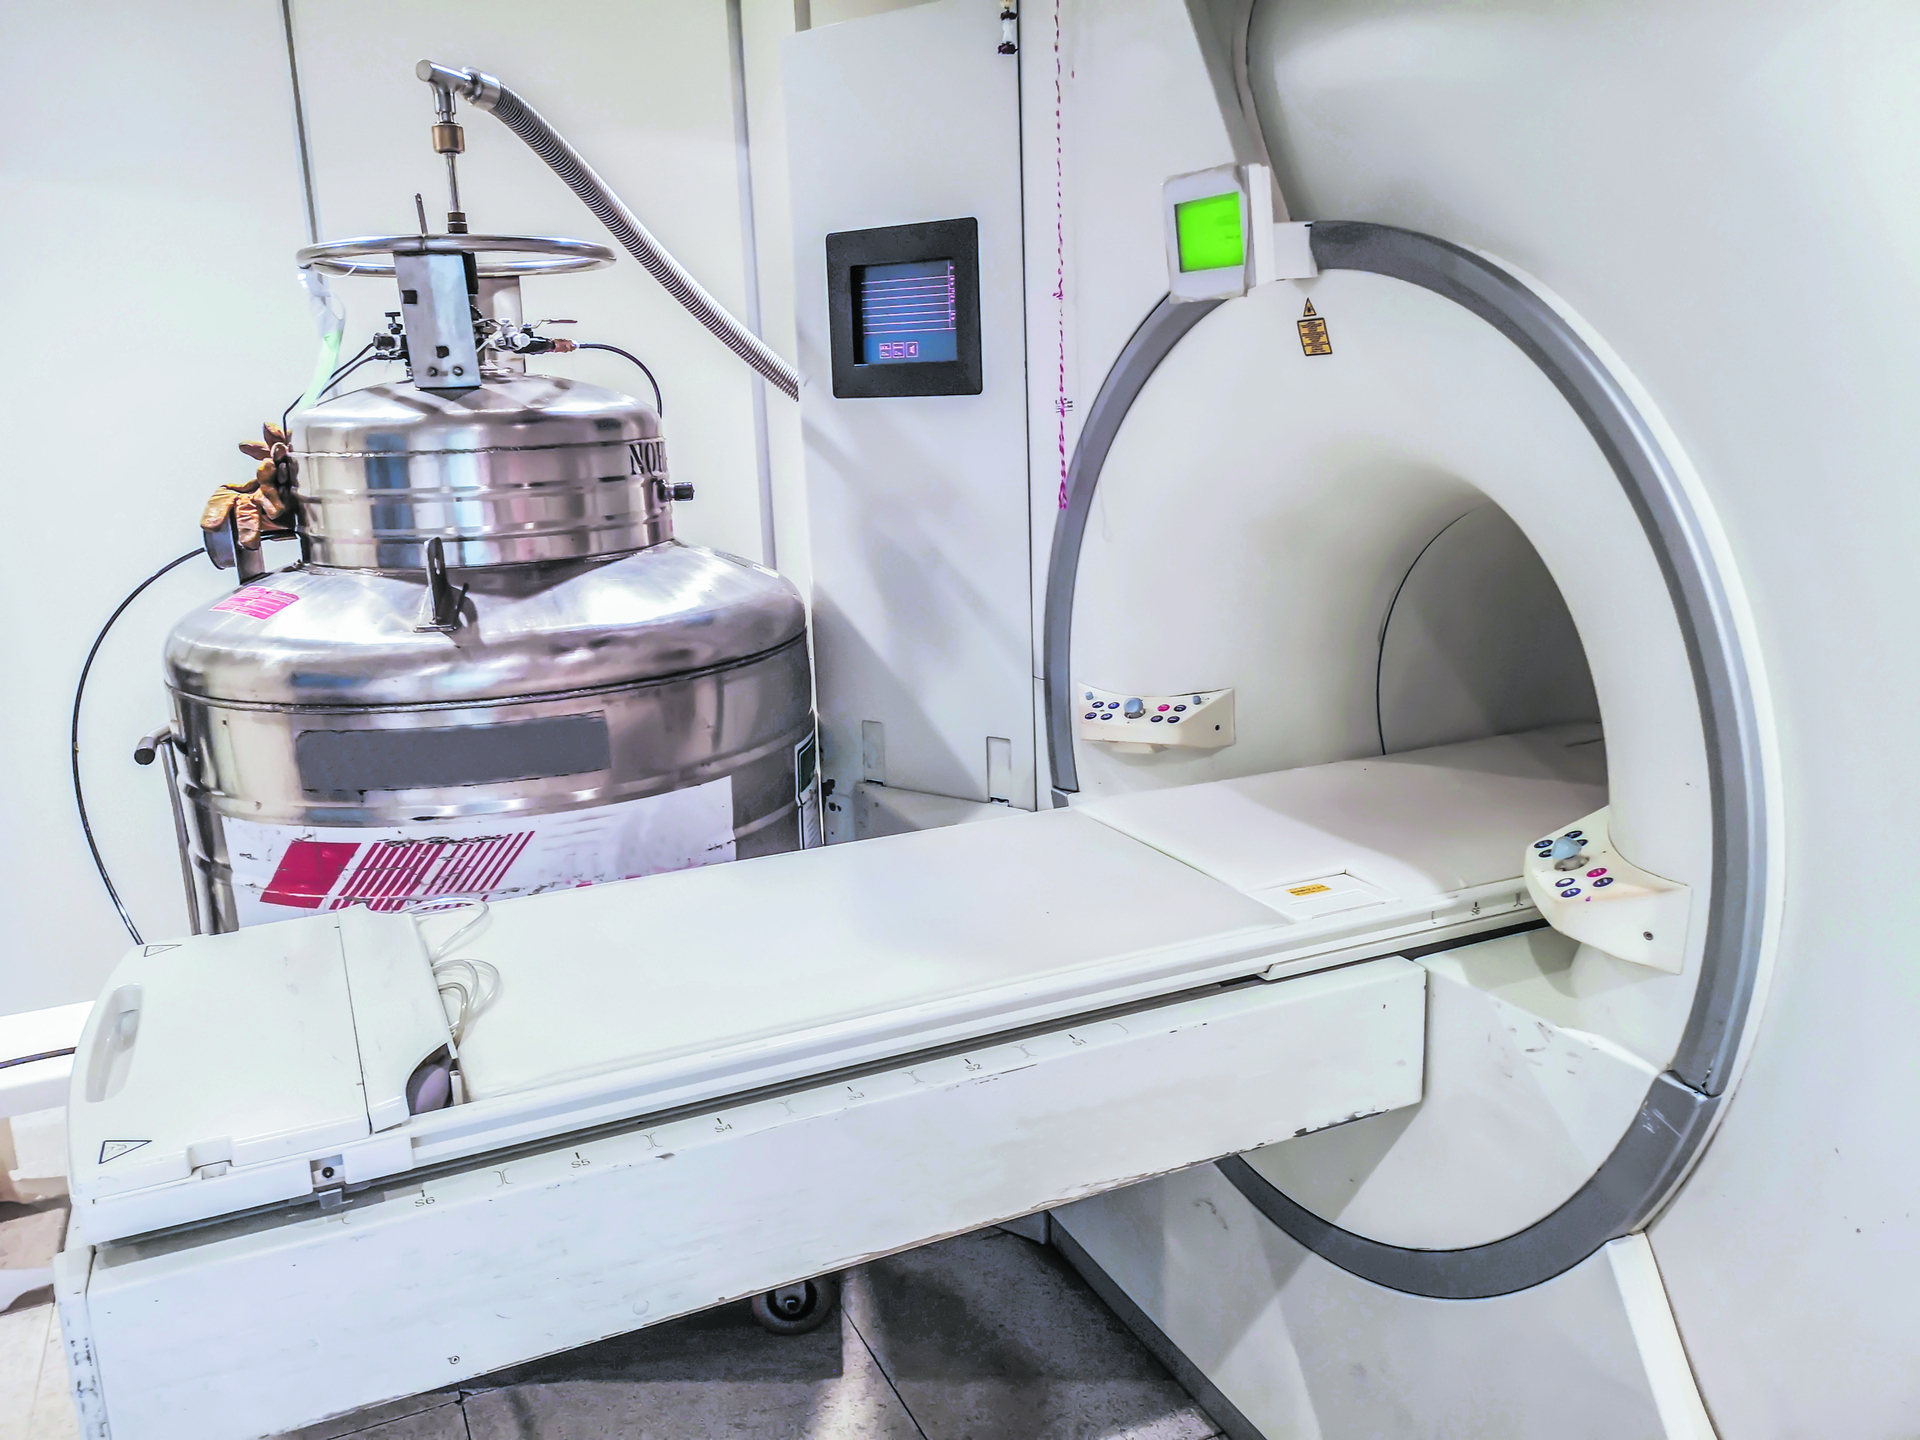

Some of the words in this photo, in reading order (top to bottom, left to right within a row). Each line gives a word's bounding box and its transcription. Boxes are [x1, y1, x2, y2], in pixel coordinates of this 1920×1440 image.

[965, 1063, 983, 1072] S2
[848, 1091, 865, 1101] S3
[714, 1123, 733, 1133] S4
[571, 1158, 591, 1169] S5
[414, 1196, 436, 1208] S6
